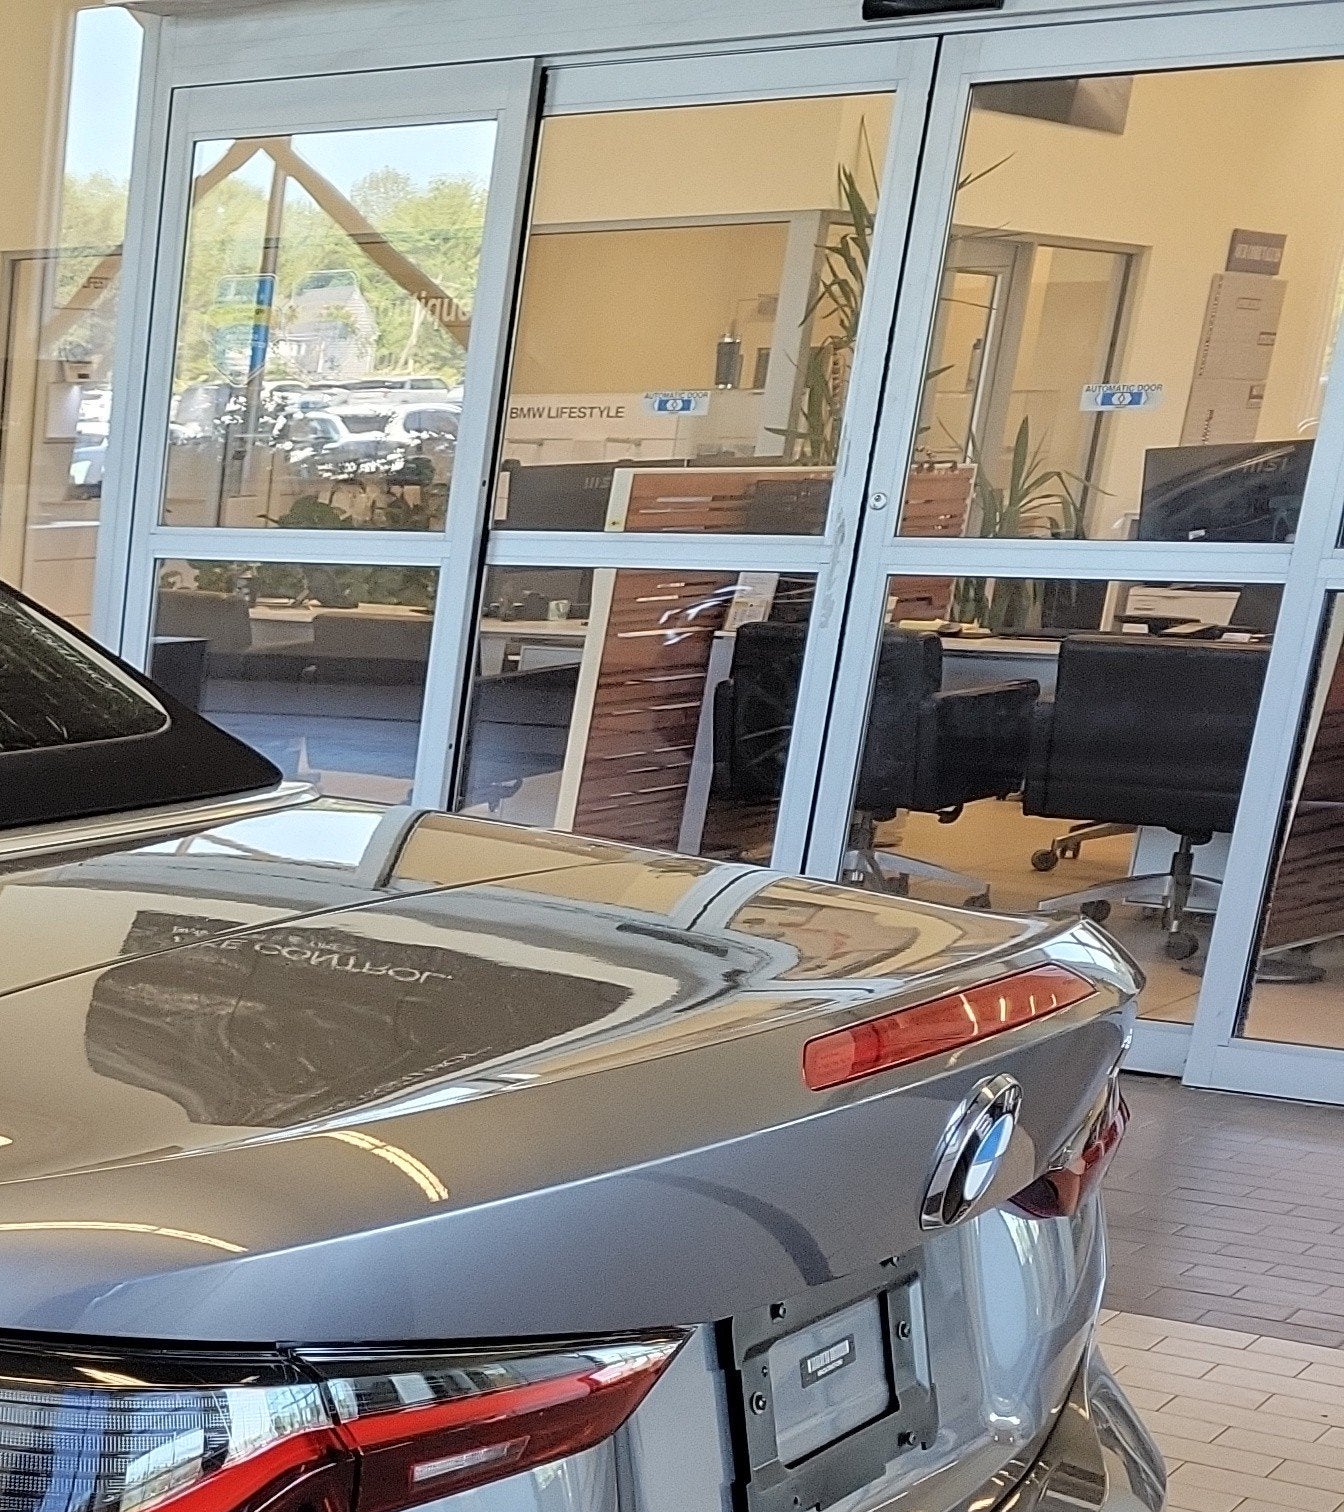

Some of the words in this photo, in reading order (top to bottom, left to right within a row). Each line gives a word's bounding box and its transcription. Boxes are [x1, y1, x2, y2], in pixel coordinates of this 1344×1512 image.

[1085, 384, 1135, 393] AUTOMATIC
[1136, 383, 1163, 392] DOOR
[644, 391, 685, 400] AUTOMATIC
[686, 390, 710, 399] DOOR
[509, 406, 545, 420] BMW
[546, 405, 626, 420] LIFESTYLE
